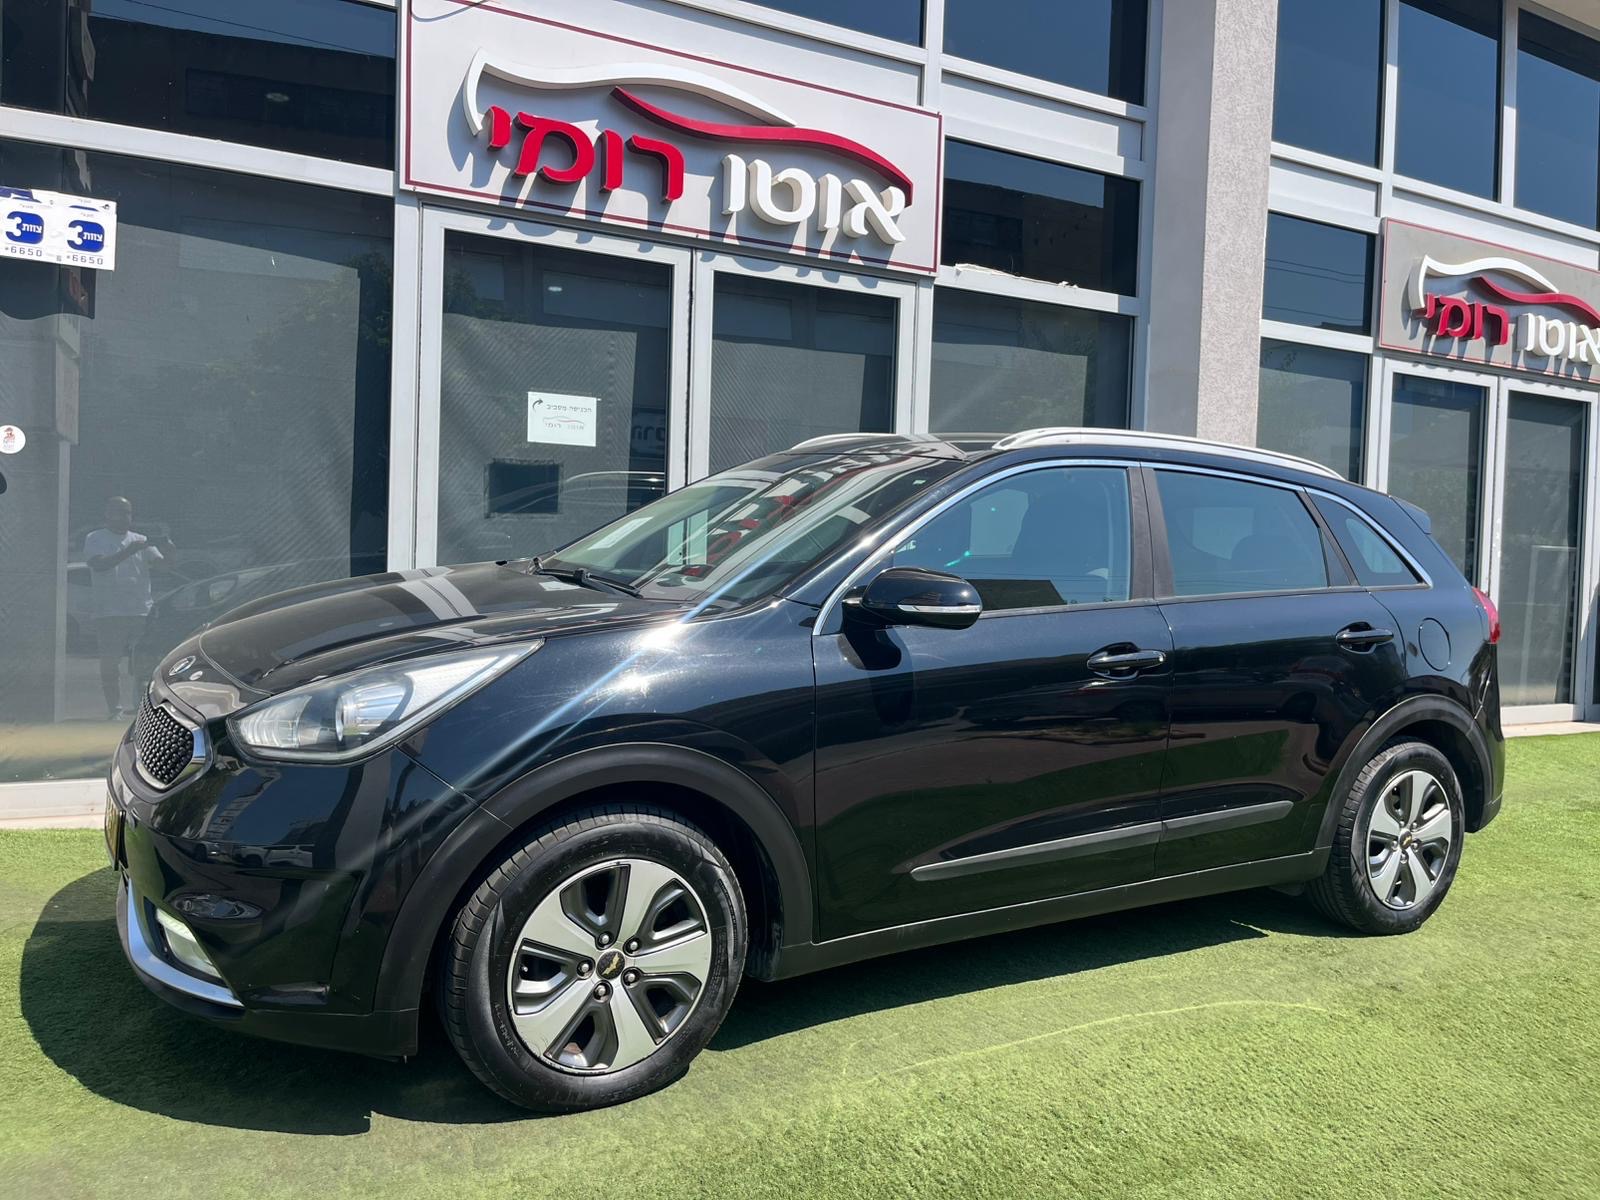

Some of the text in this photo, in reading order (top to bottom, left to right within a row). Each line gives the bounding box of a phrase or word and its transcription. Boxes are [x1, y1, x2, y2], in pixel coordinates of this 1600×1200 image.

[485, 105, 906, 245] אוטו רומי
[6, 216, 43, 237] צוות 3
[67, 225, 103, 245] צוות 3
[1422, 292, 1509, 346] רומי
